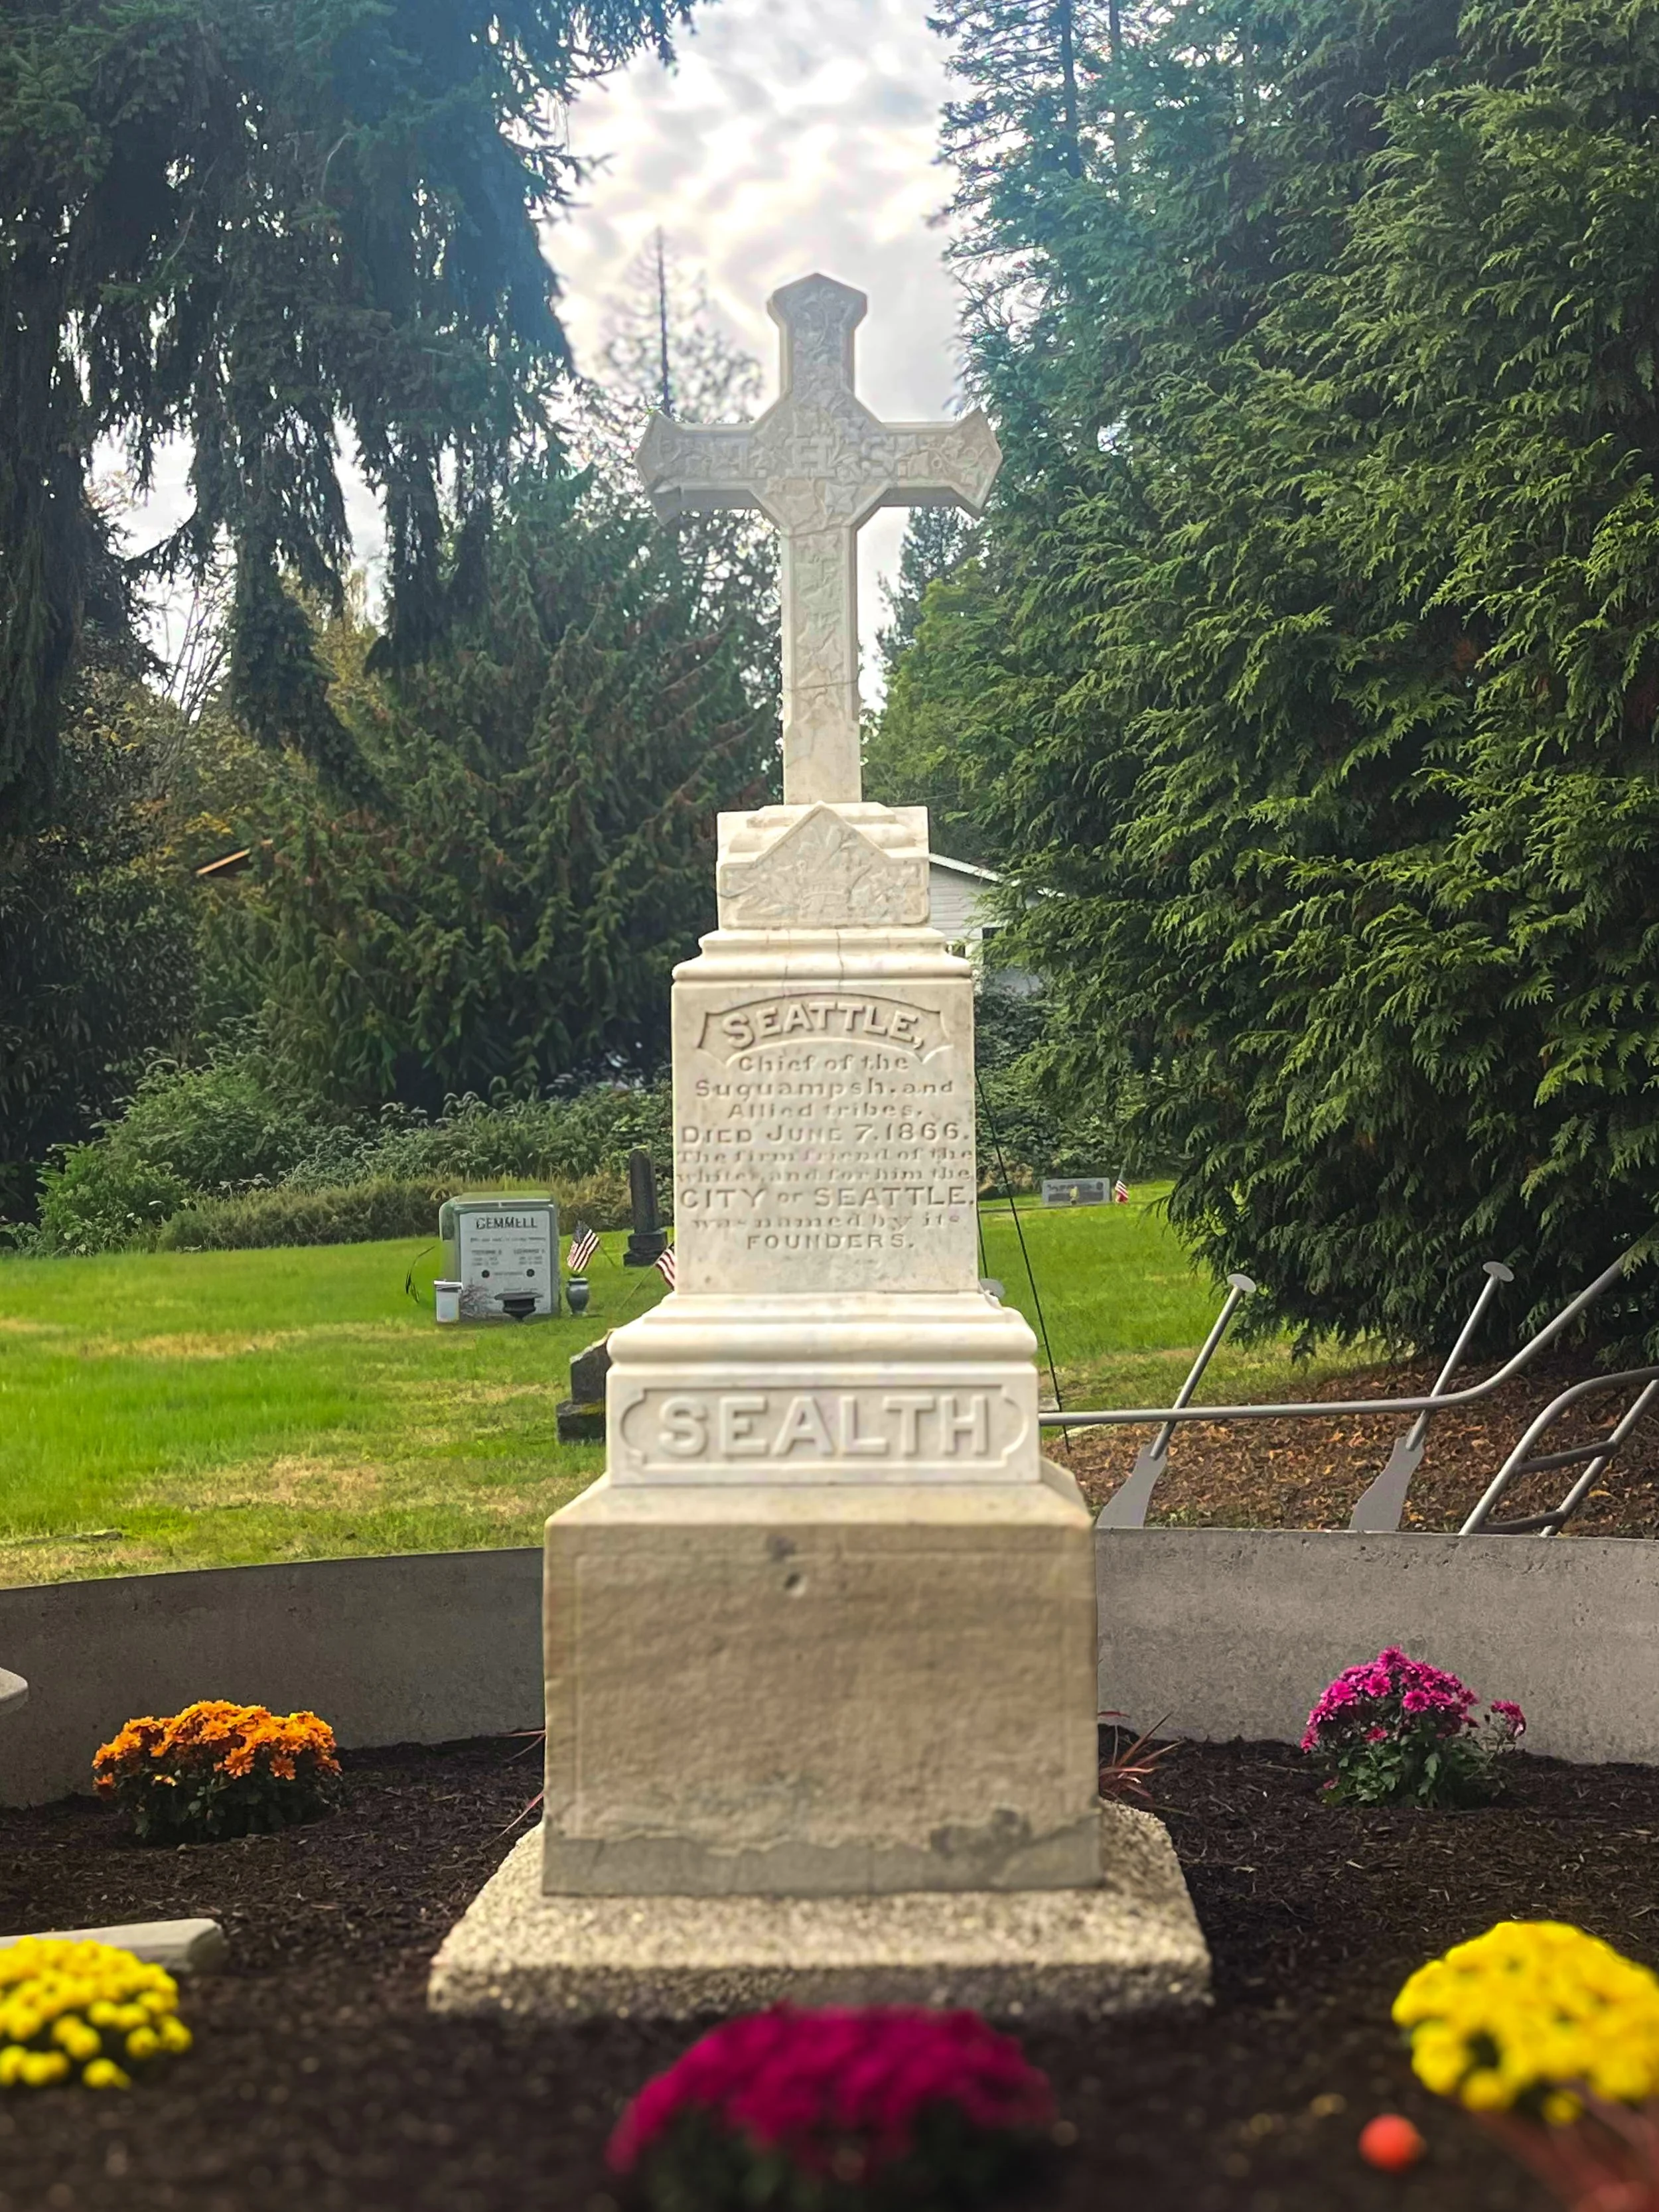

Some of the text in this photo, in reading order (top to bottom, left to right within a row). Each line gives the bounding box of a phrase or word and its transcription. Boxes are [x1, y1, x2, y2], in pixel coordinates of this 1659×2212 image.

[723, 1002, 924, 1049] SEATTLE,
[739, 1053, 908, 1071] Chief of the
[902, 1079, 954, 1093] and
[728, 1103, 812, 1119] Allied
[677, 1146, 973, 1162] The firm friend of the
[829, 1168, 870, 1181] for
[876, 1167, 923, 1181] him
[680, 1187, 766, 1209] CITY
[476, 1216, 538, 1230] GEMMELL
[755, 1213, 861, 1227] named
[873, 1213, 912, 1231] by
[747, 1233, 914, 1250] FOUNDERS.
[658, 1395, 989, 1458] SEALTH
